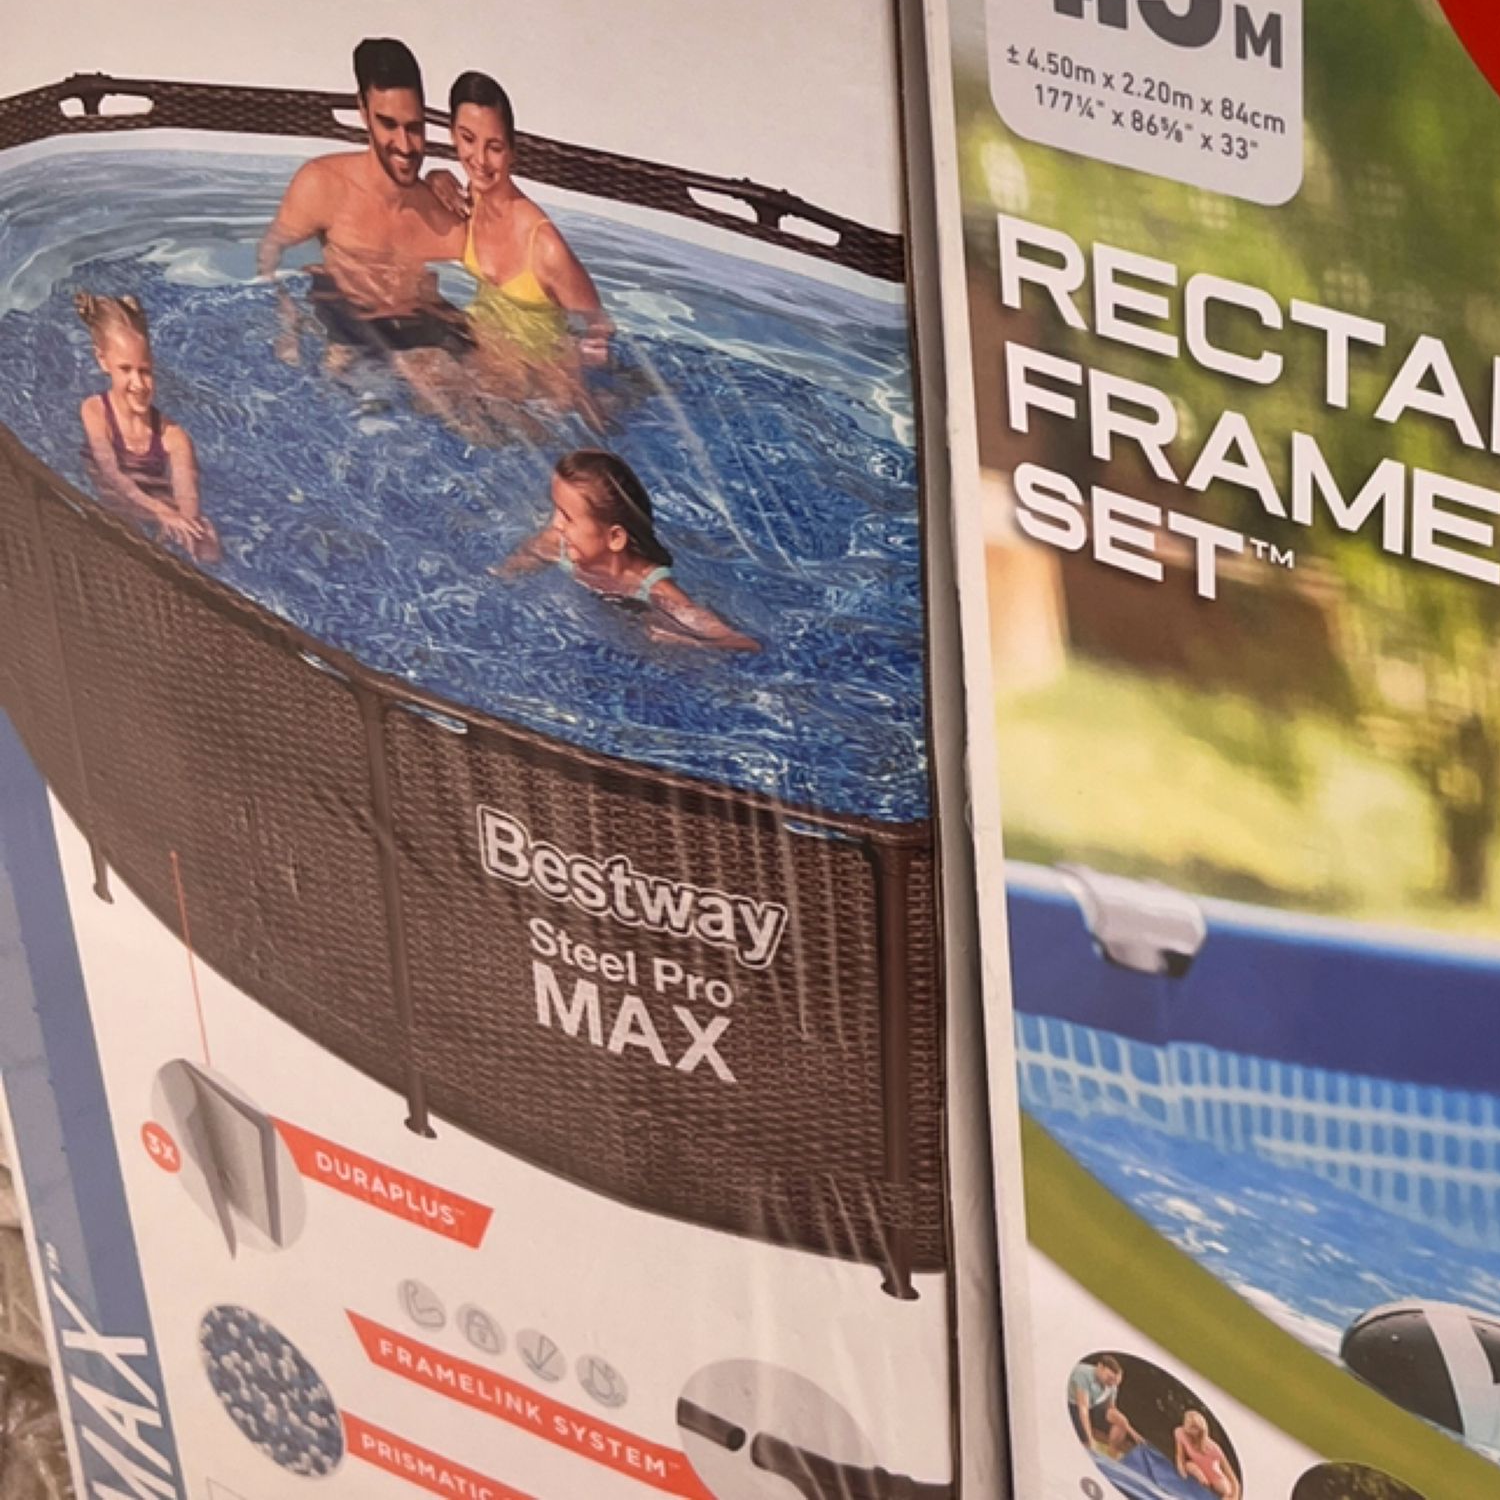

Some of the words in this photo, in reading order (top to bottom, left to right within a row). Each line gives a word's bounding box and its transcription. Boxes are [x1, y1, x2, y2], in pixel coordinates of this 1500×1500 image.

[1026, 47, 1096, 85] 4.50m
[1122, 71, 1194, 111] 2.20m
[1220, 97, 1286, 135] 84cm
[1009, 460, 1249, 602] SET
[481, 808, 784, 965] Bestway
[528, 917, 637, 987] Steel
[652, 956, 734, 1009] Pro
[531, 959, 738, 1084] MAX
[314, 1150, 457, 1226] DURAPLUS
[378, 1337, 544, 1426] FRAMELINK
[552, 1414, 668, 1479] SYSTEM
[360, 1431, 496, 1500] PRISMATIC
